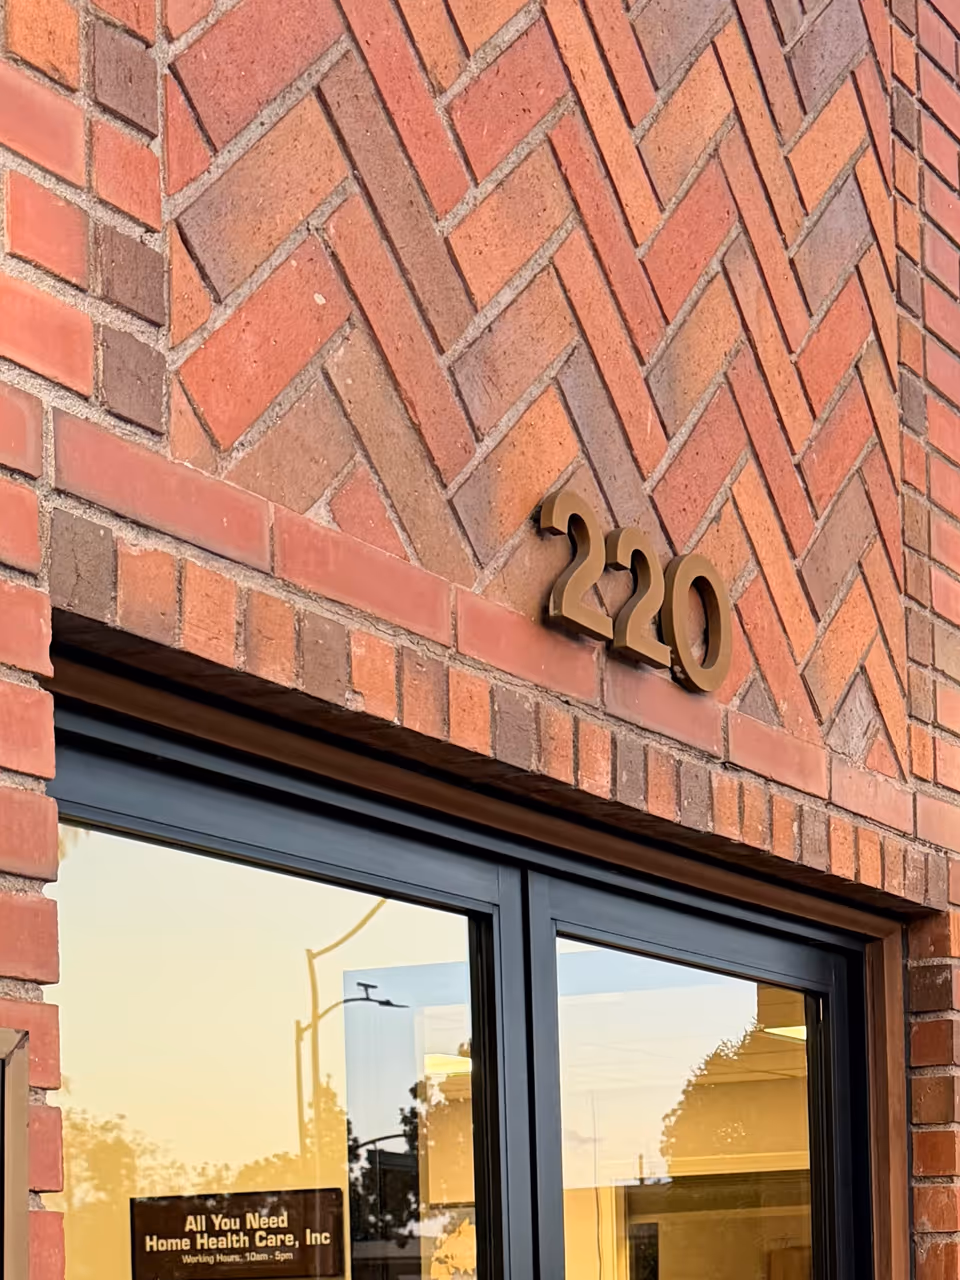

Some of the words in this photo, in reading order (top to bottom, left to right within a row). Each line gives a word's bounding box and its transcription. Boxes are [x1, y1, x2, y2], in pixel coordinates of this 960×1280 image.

[540, 490, 733, 692] 220
[184, 1215, 206, 1232] All
[211, 1214, 240, 1231] You
[246, 1211, 288, 1229] Need
[145, 1235, 191, 1252] Home
[196, 1232, 249, 1250] Health
[255, 1230, 300, 1248] Care,
[306, 1228, 331, 1245] Inc
[181, 1254, 215, 1265] Working
[216, 1253, 243, 1262] Hours:
[245, 1251, 268, 1261] 10am
[275, 1250, 294, 1262] 5pm
